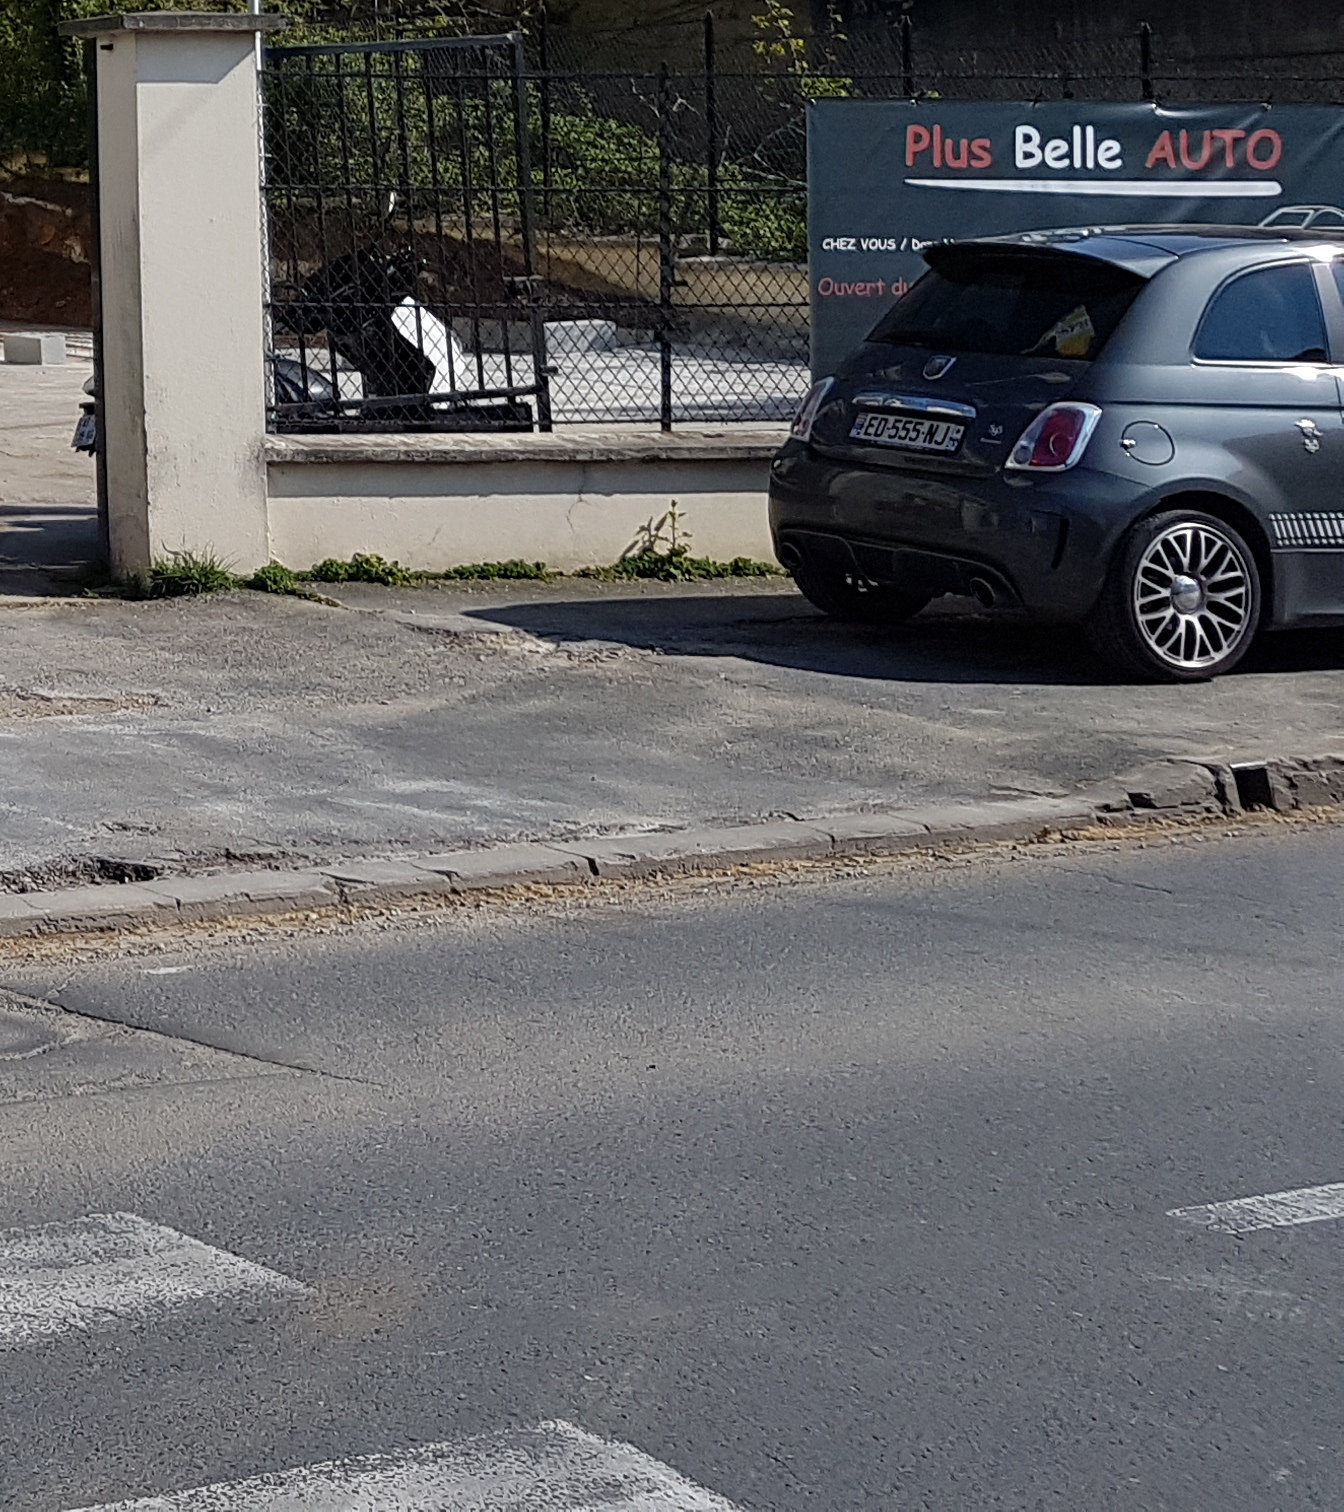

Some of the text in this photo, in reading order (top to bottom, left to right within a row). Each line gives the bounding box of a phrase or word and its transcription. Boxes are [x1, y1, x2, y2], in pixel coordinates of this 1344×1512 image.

[904, 123, 1283, 170] Plus Belle AUTO
[821, 237, 857, 250] CHEZ
[861, 237, 897, 251] VOUS
[817, 277, 886, 297] Ouvert
